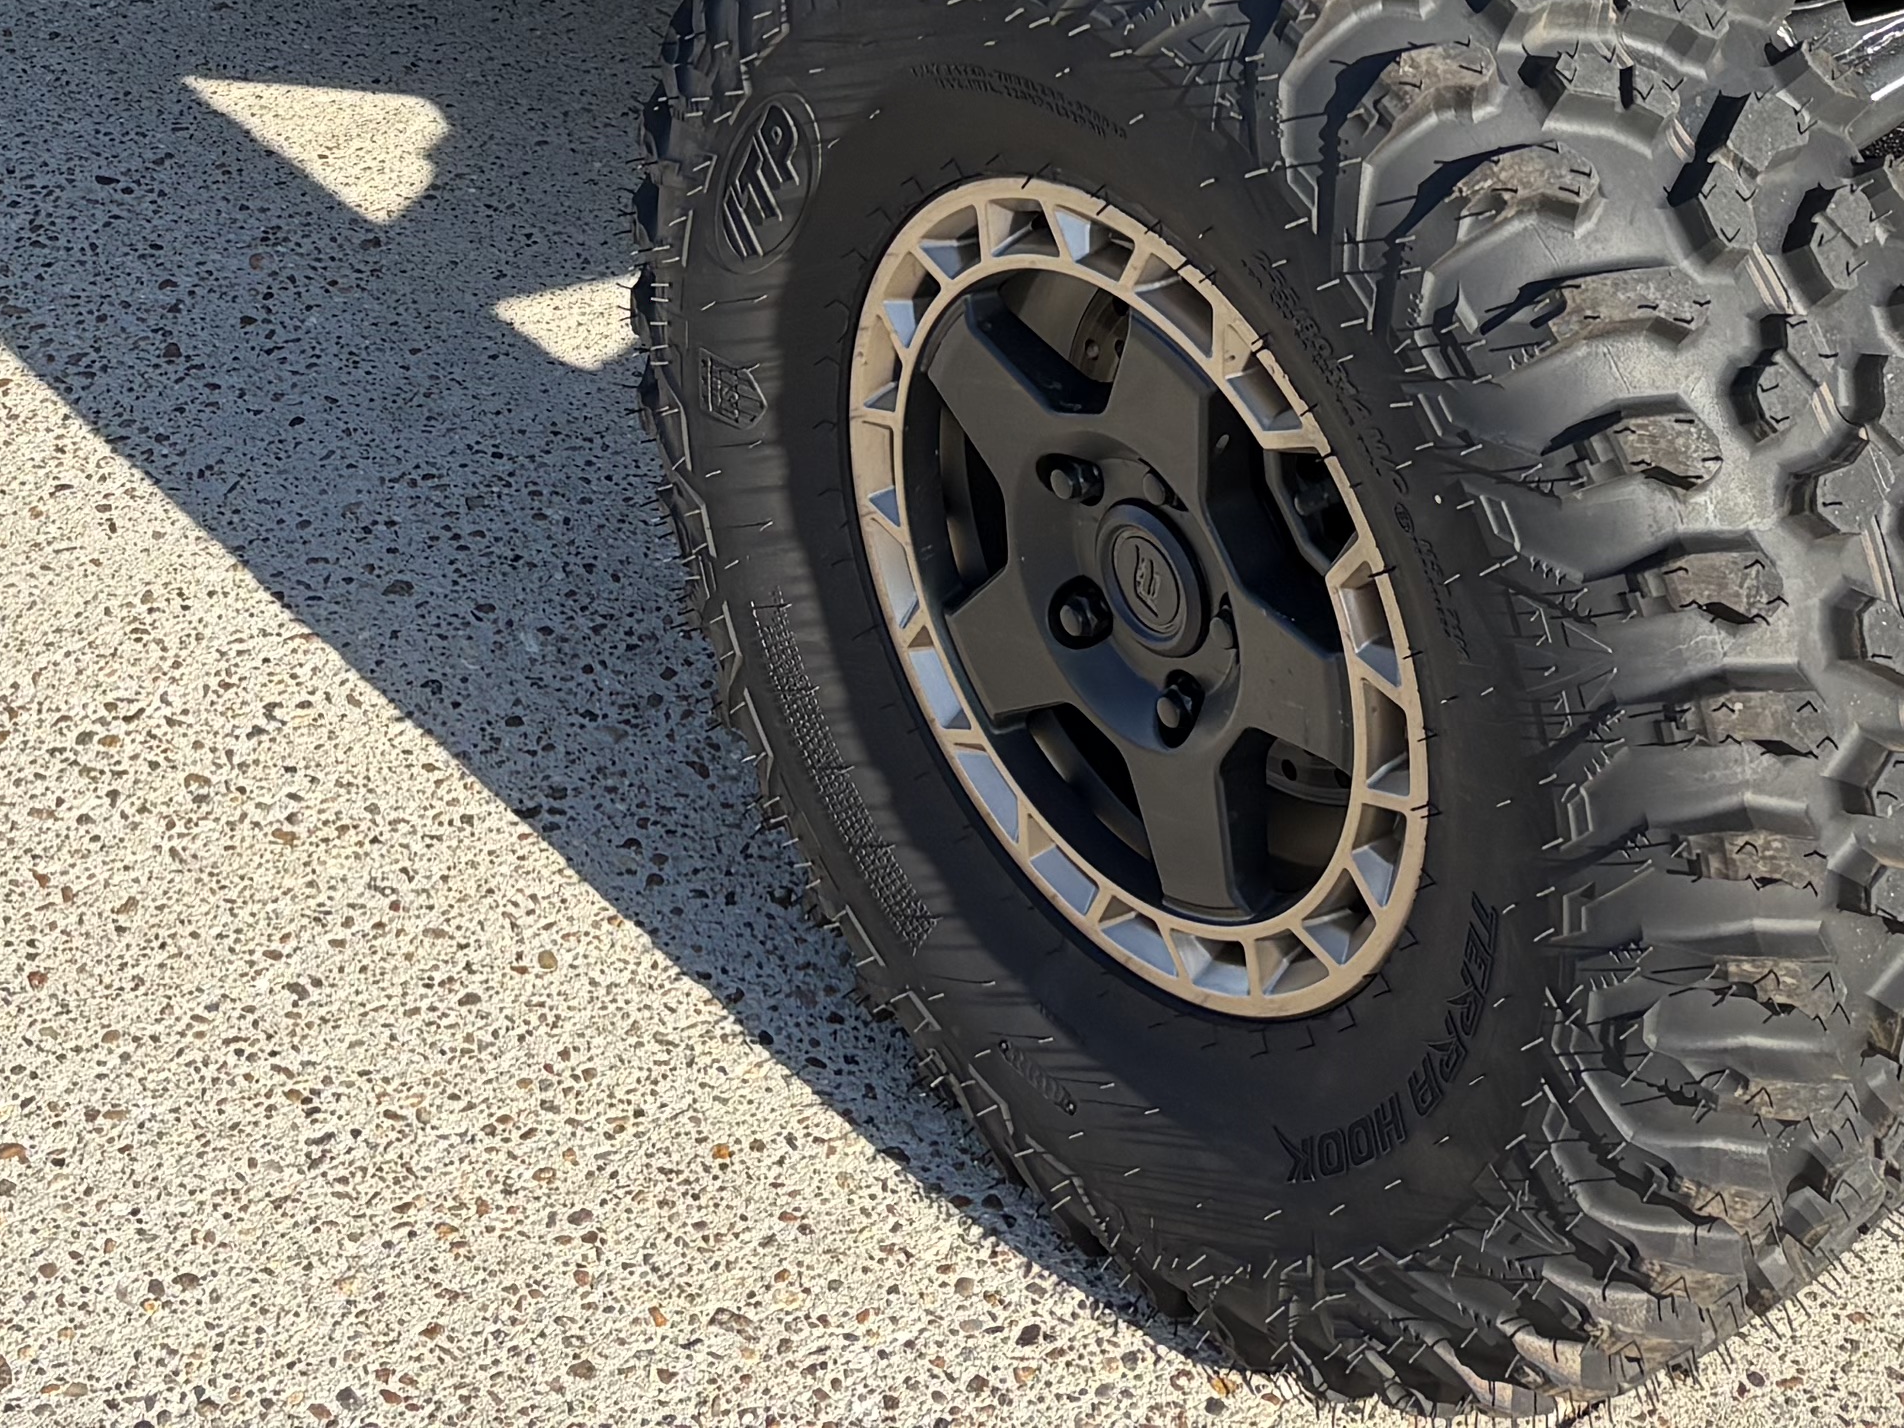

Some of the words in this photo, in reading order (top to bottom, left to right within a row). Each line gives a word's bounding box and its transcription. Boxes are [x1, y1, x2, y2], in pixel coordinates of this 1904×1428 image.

[723, 101, 806, 263] ITP
[1407, 892, 1500, 1118] TERRA
[1274, 1097, 1407, 1184] HOOK
